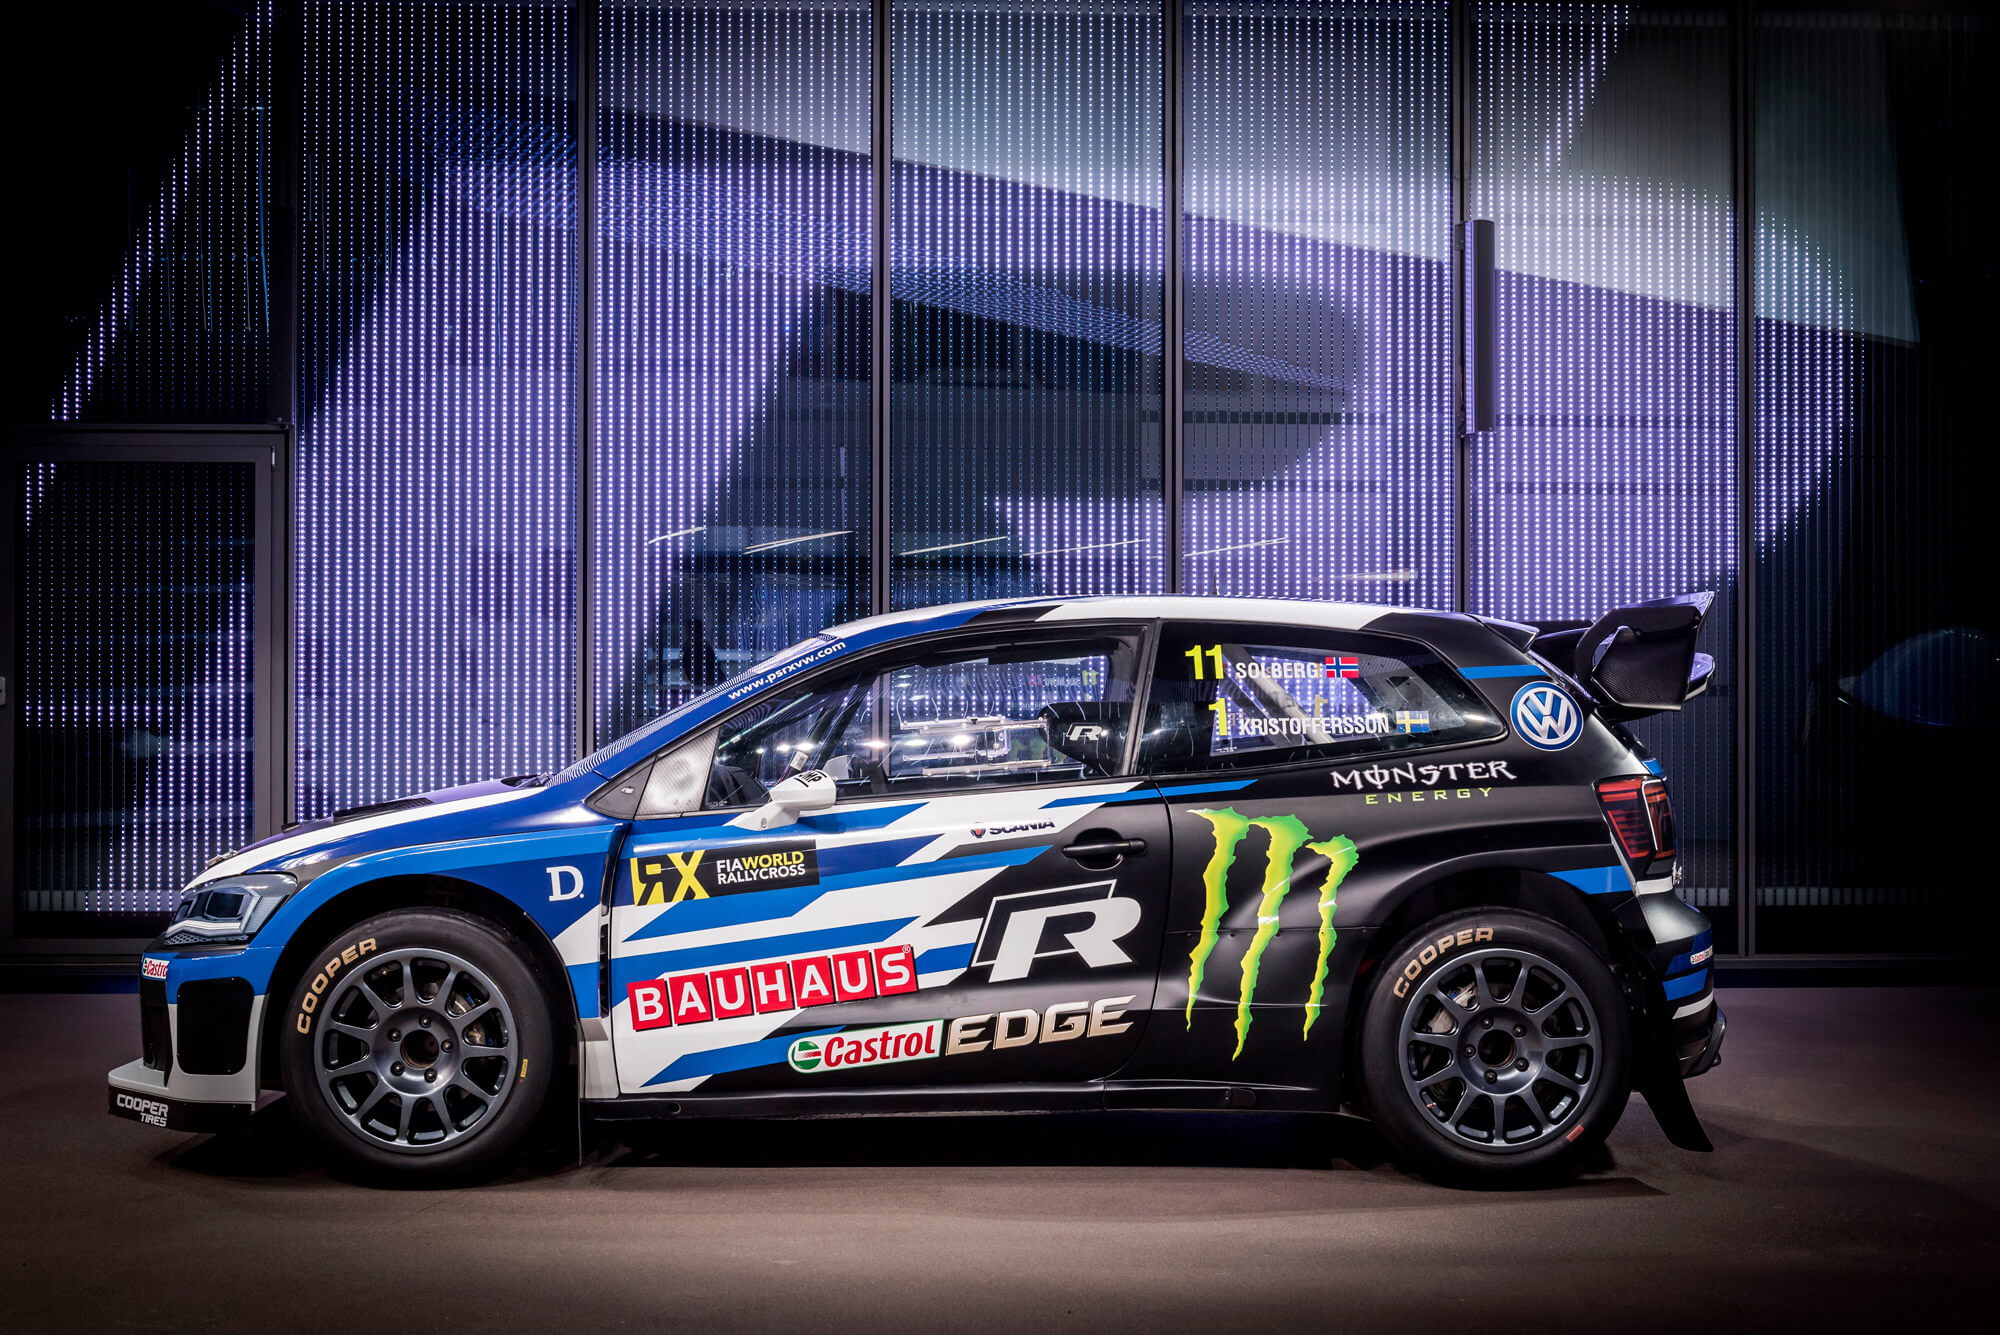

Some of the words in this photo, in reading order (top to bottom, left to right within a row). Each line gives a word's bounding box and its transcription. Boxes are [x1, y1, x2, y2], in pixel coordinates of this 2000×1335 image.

[728, 641, 847, 700] www.psrxvw.com
[1185, 645, 1225, 680] 11
[1235, 662, 1320, 679] SOLBERG
[1066, 722, 1103, 741] R
[1208, 697, 1228, 736] 1
[1239, 716, 1390, 736] KRISTOFFERSSON
[1517, 687, 1577, 744] VW
[1330, 760, 1518, 791] MONSTER
[1365, 787, 1492, 805] ENERGY
[545, 865, 585, 902] D.
[717, 863, 806, 885] RALLYCROSS
[978, 887, 1142, 983] R
[1393, 927, 1494, 999] COOPER
[296, 938, 377, 1035] COOPER
[823, 1025, 936, 1068] Castrol
[945, 994, 1137, 1056] EDGE
[116, 1093, 169, 1117] COOPER
[140, 1112, 168, 1127] TIRES
